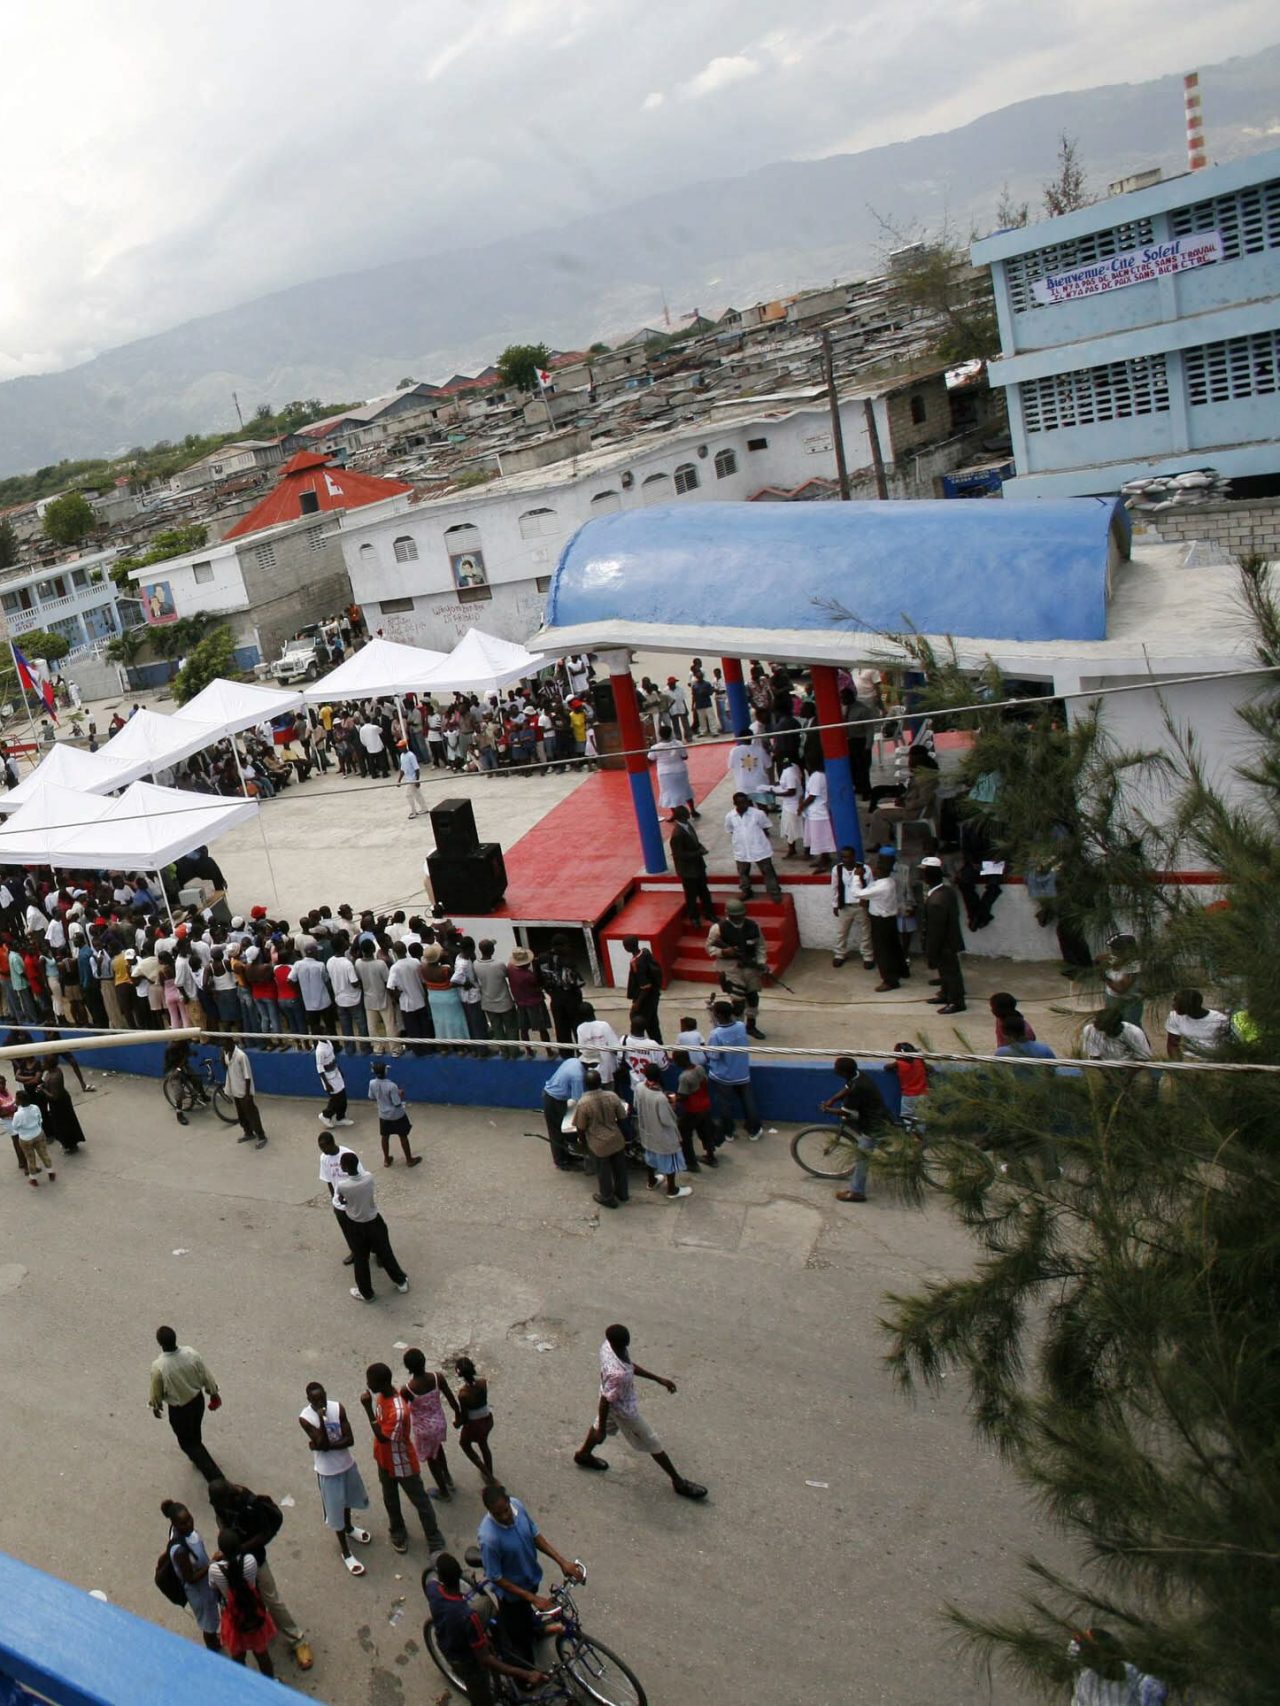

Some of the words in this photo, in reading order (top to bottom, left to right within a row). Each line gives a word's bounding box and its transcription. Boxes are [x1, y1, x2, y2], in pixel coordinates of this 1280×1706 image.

[1142, 240, 1180, 263] Soleil
[1155, 255, 1177, 267] SANS
[1181, 244, 1217, 259] TRAVAIL
[1114, 276, 1132, 287] PAIX
[1134, 270, 1155, 281] SANS
